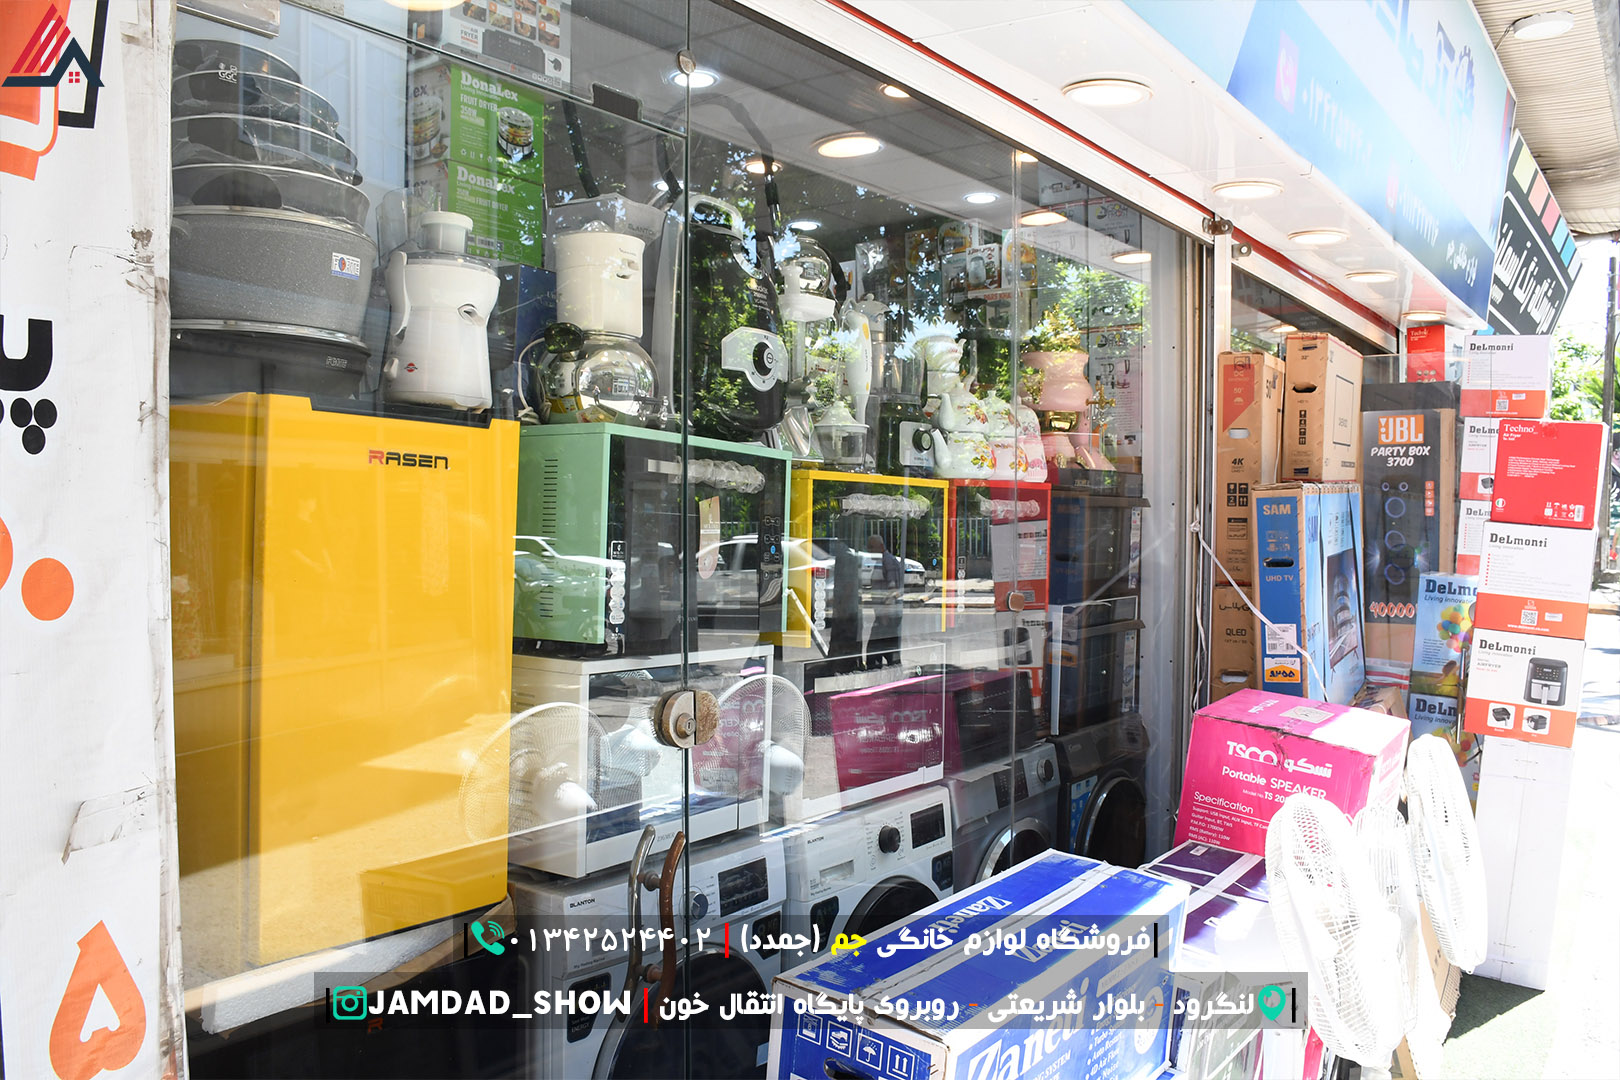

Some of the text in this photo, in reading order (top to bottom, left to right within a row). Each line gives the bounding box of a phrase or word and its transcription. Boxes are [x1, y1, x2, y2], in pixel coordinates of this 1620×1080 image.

[460, 93, 498, 113] FRUIT DRYER
[1380, 416, 1424, 443] JBL
[1469, 425, 1499, 434] DeLm
[1503, 424, 1535, 433] Techno
[1370, 446, 1432, 457] PARTY BOX
[368, 449, 449, 470] RASEN
[1231, 458, 1244, 466] 4K
[1386, 457, 1415, 467] 3700
[1263, 504, 1292, 515] SAM
[1465, 508, 1492, 517] DeLm
[1489, 533, 1548, 548] DeLmonti
[1424, 579, 1477, 596] DeLm
[1369, 601, 1418, 619] 40000
[1225, 628, 1247, 637] QLED
[1479, 639, 1537, 656] DeLmonti
[1414, 714, 1434, 723] Living
[1227, 740, 1278, 766] TSCO
[1284, 758, 1333, 779] تسکو
[1222, 766, 1327, 800] Portable SPEAKER
[1193, 791, 1254, 814] Specification
[1264, 791, 1273, 801] TS
